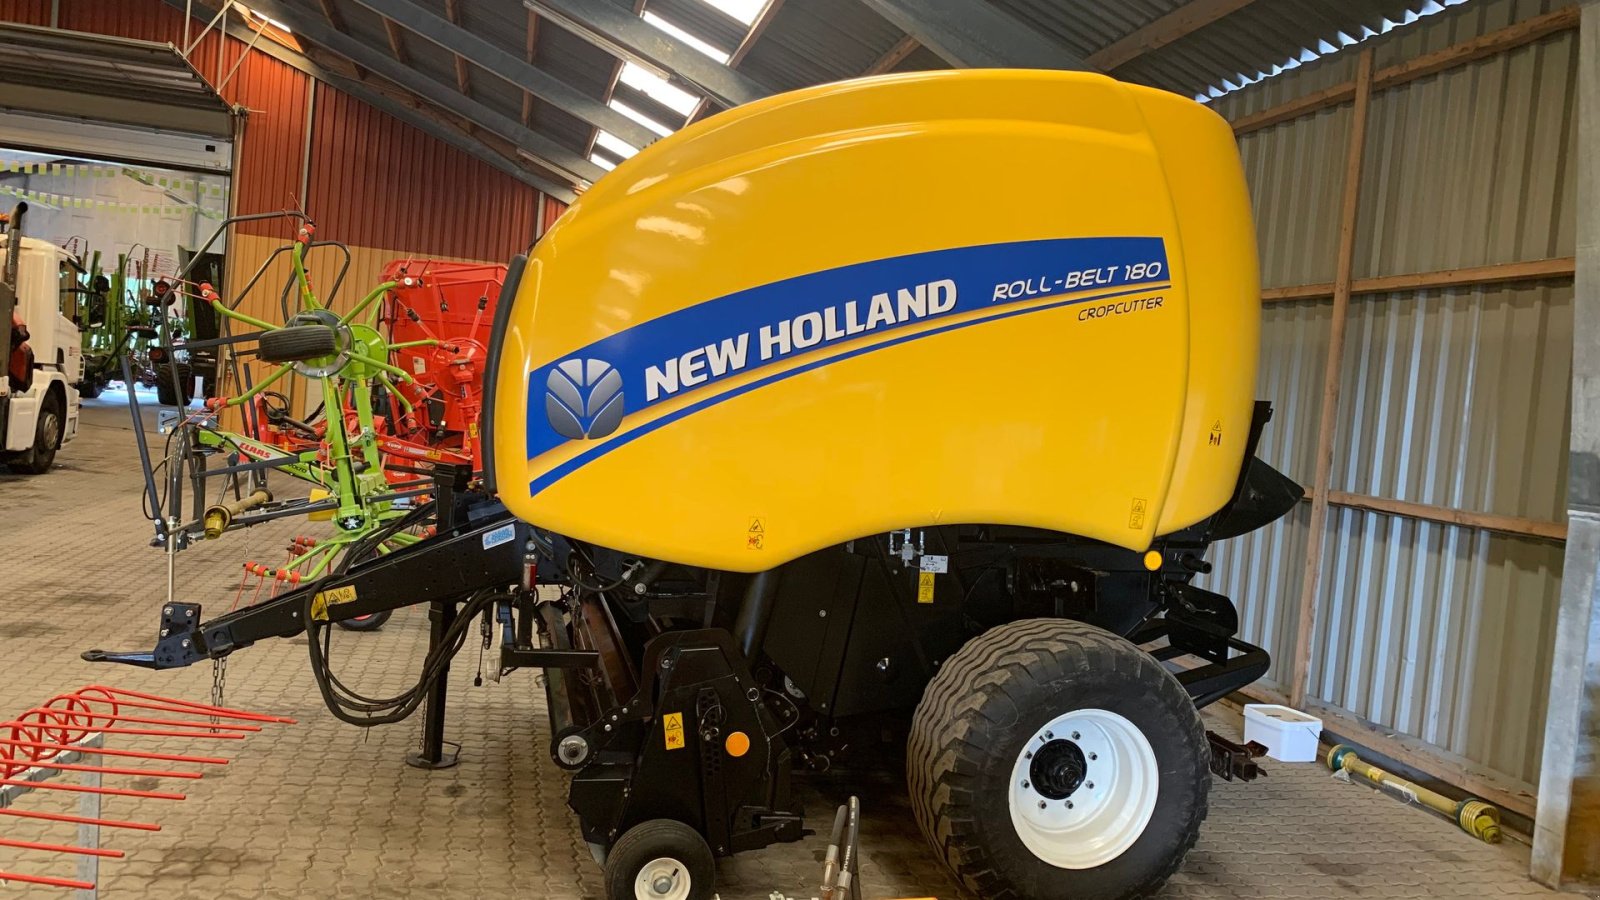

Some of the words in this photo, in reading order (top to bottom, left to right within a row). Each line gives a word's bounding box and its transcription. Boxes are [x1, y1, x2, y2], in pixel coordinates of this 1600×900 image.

[992, 266, 1119, 302] ROLL-BELT
[1124, 262, 1162, 281] 180
[1078, 297, 1164, 321] CROPCUTTER
[645, 333, 749, 402] NEW
[759, 279, 957, 361] HOLLAND
[239, 442, 271, 459] CLAAS
